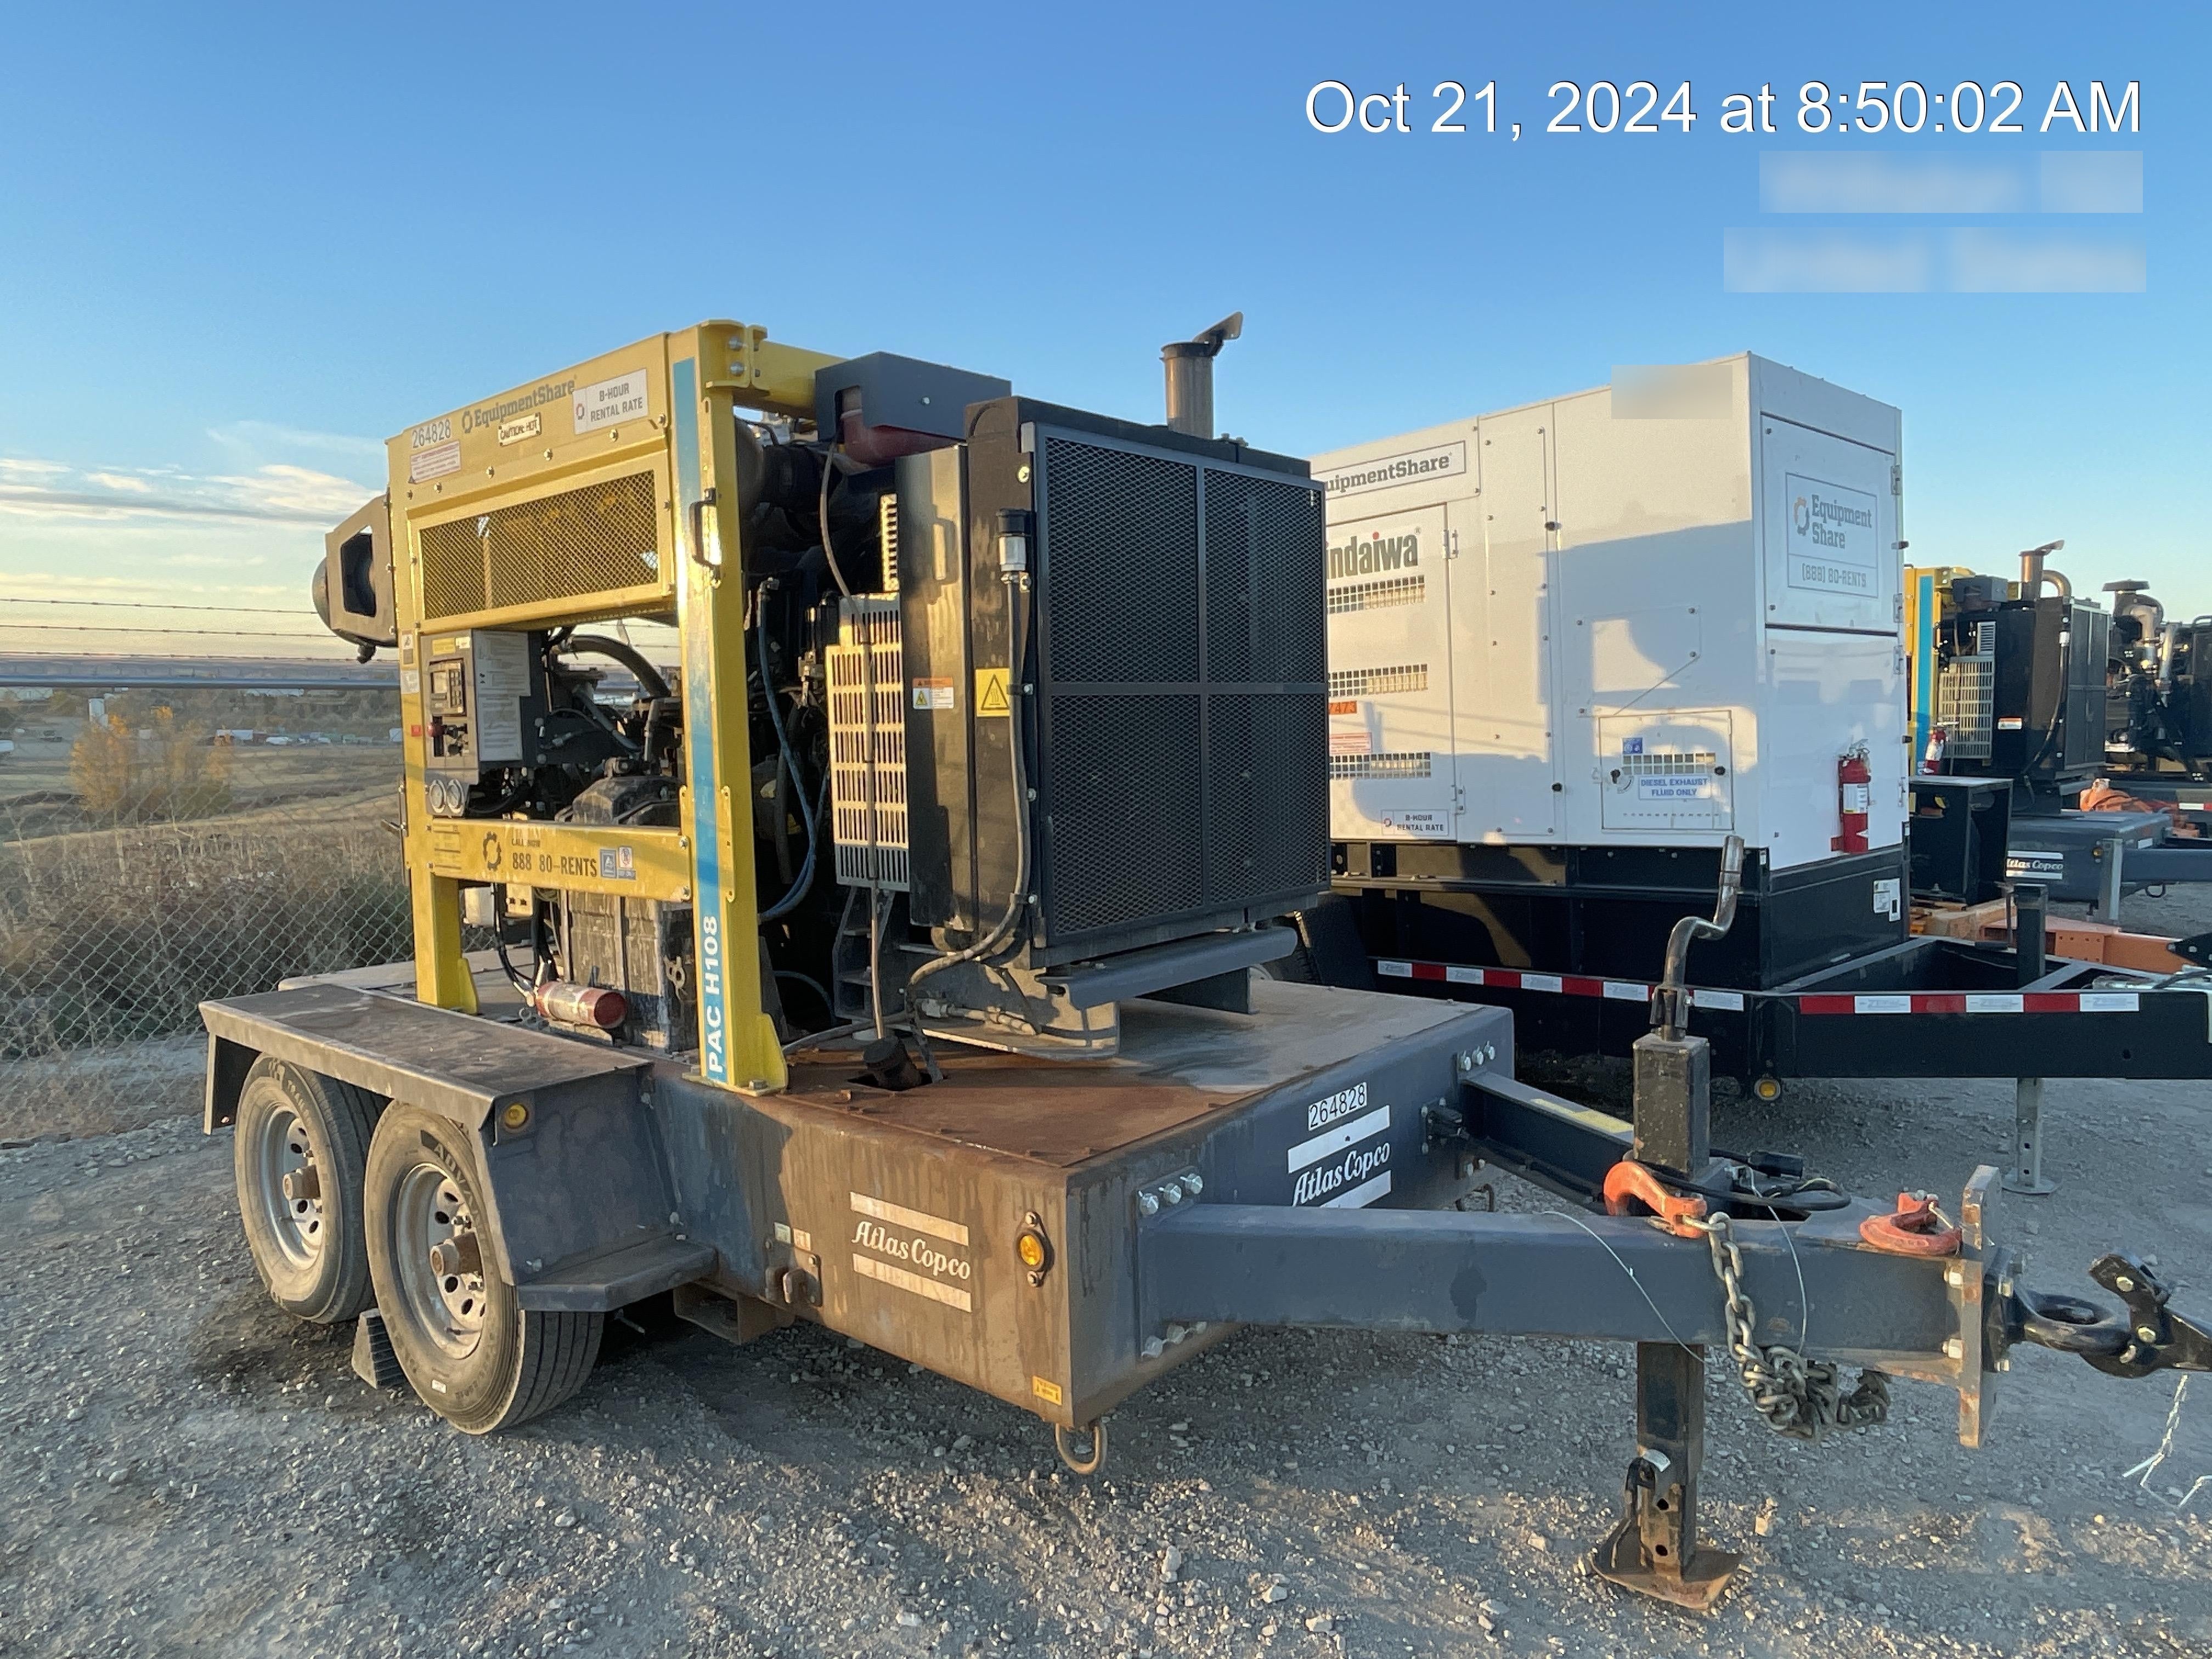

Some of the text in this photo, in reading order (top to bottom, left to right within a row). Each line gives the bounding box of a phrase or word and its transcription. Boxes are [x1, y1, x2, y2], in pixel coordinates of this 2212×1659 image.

[475, 379, 574, 427] EquipmentShare
[599, 382, 630, 402] 8-HOUR
[590, 397, 643, 422] RENTAL RATE
[413, 419, 451, 449] 264828
[1327, 455, 1449, 493] uipmentShare
[1812, 494, 1872, 528] Equipment
[1812, 522, 1846, 549] Share
[1327, 531, 1419, 579] ndaiwa
[1641, 778, 1668, 787] DIESEL
[512, 853, 597, 878] 888 80-RENTS
[2032, 860, 2064, 871] Copco
[703, 916, 723, 1073] PAC H108
[1309, 1084, 1366, 1128] 264828
[1291, 1142, 1390, 1207] Atlas Copco
[851, 1221, 909, 1260] Atlas
[911, 1238, 970, 1279] Copco
